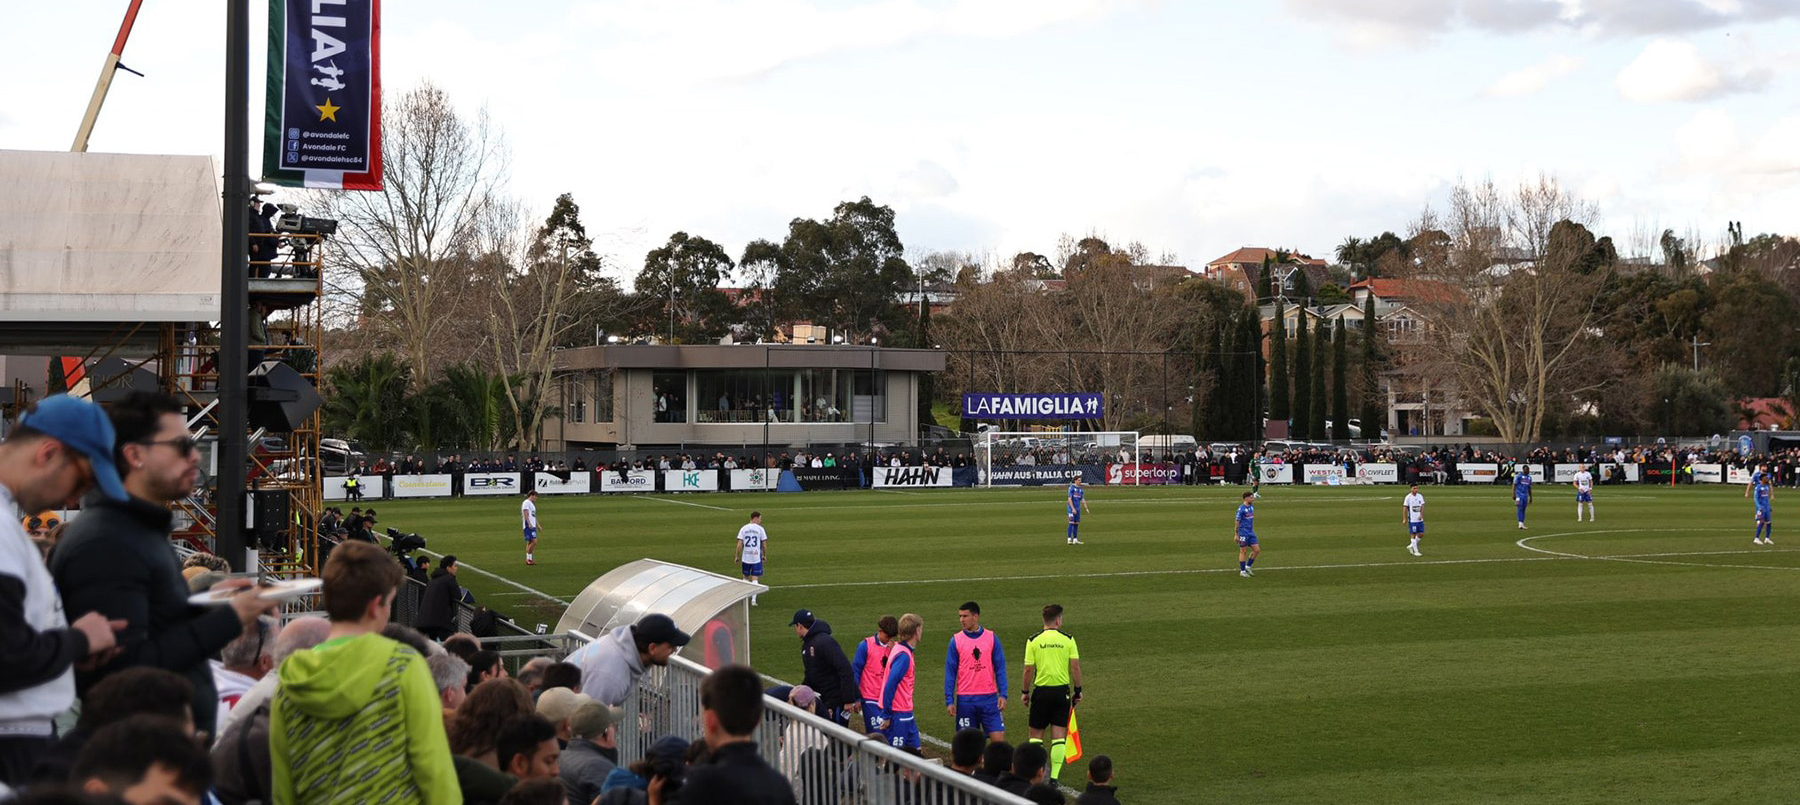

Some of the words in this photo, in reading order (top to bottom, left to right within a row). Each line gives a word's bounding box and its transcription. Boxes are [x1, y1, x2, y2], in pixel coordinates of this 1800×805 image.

[302, 131, 350, 139] @avondalefc
[885, 468, 940, 485] HAHN
[990, 472, 1014, 480] HAHN
[1065, 470, 1083, 478] CUP
[1124, 467, 1178, 480] superloop
[745, 535, 758, 548] 23
[958, 717, 970, 727] 45
[892, 736, 904, 746] 25
